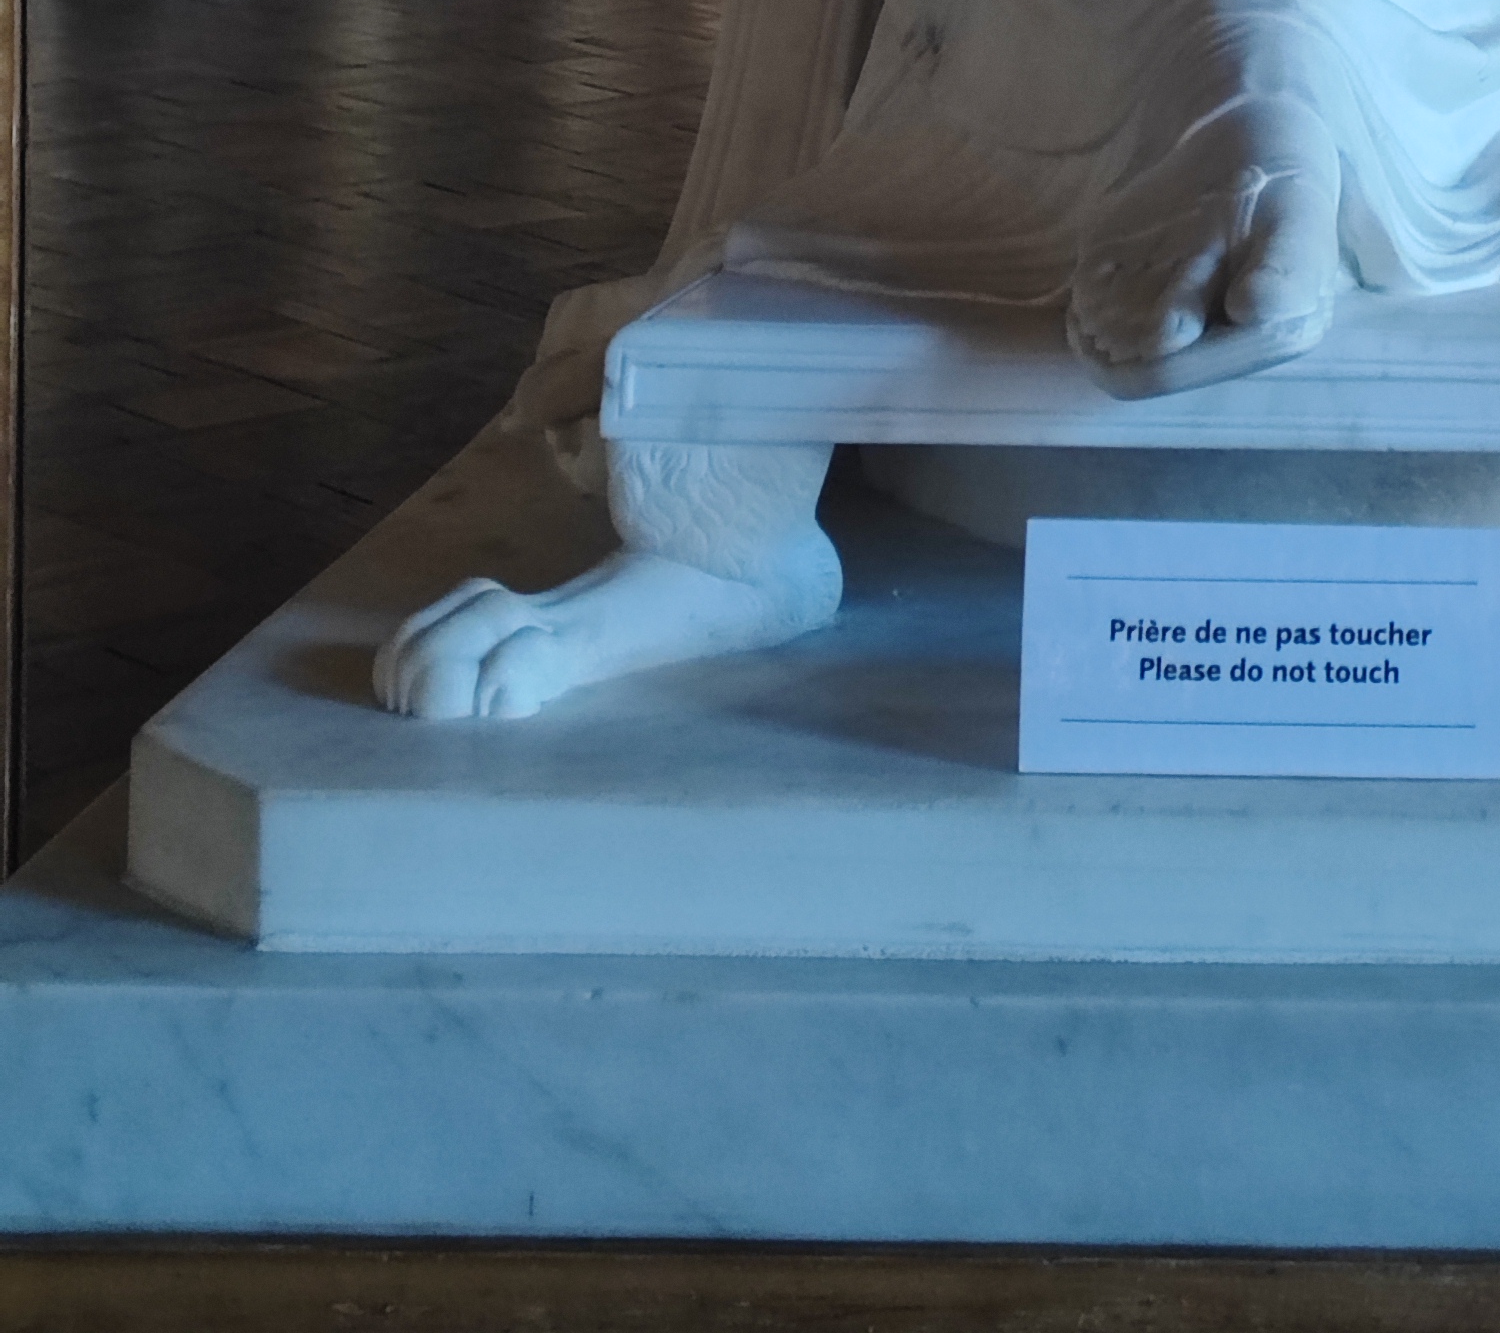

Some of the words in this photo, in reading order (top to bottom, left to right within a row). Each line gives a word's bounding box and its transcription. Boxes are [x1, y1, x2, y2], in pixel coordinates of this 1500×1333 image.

[1109, 617, 1187, 644] Prière
[1194, 618, 1228, 644] de
[1235, 626, 1268, 645] ne
[1274, 626, 1322, 652] pas
[1328, 620, 1433, 646] toucher
[1138, 656, 1222, 682] Please
[1229, 657, 1264, 682] do
[1271, 660, 1317, 683] not
[1323, 658, 1400, 684] touch
